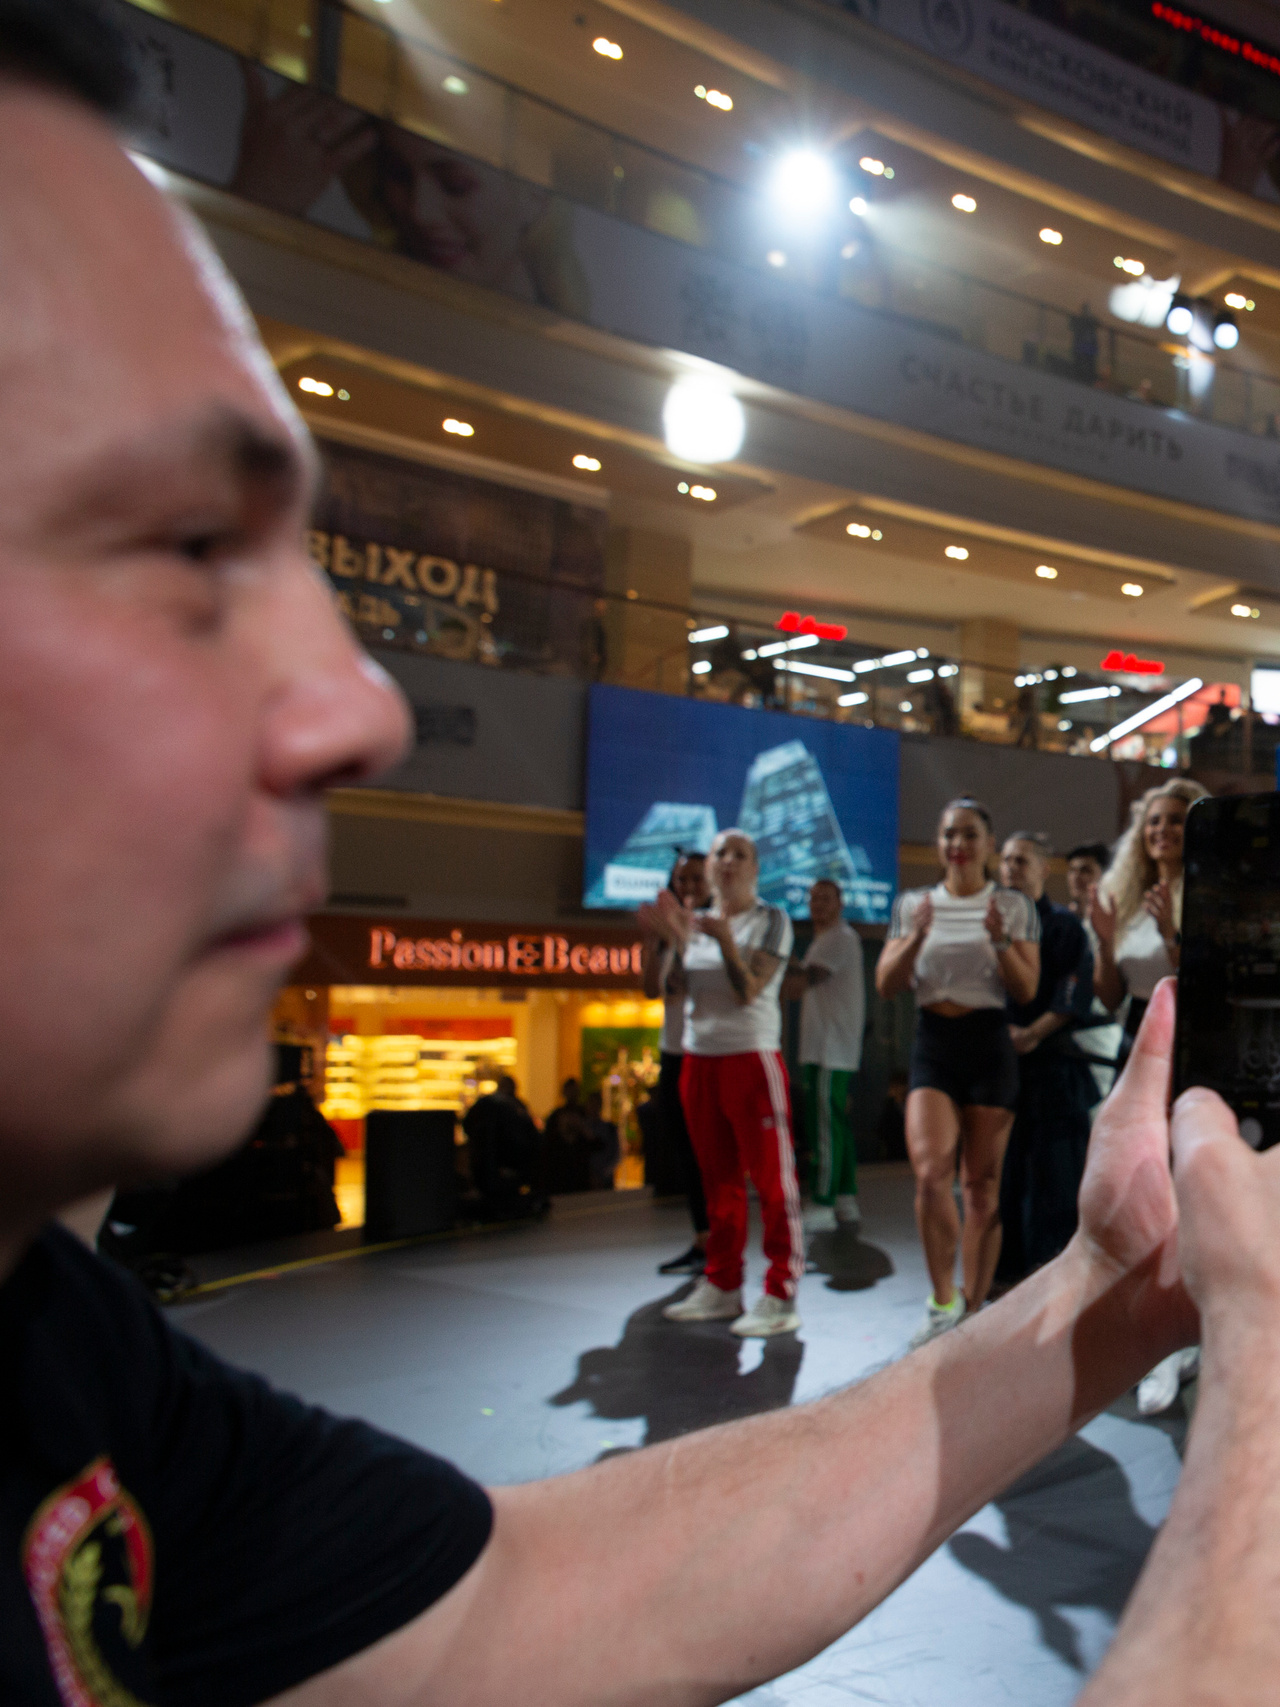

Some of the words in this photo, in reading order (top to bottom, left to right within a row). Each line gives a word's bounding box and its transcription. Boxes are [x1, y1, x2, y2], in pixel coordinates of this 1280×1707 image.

[899, 355, 1044, 422] СЧАСТЬЕ
[1062, 405, 1184, 461] ДАРИТЬ
[309, 530, 499, 616] ВЫХОД
[370, 926, 504, 972] Passion
[543, 935, 644, 974] Beaut
